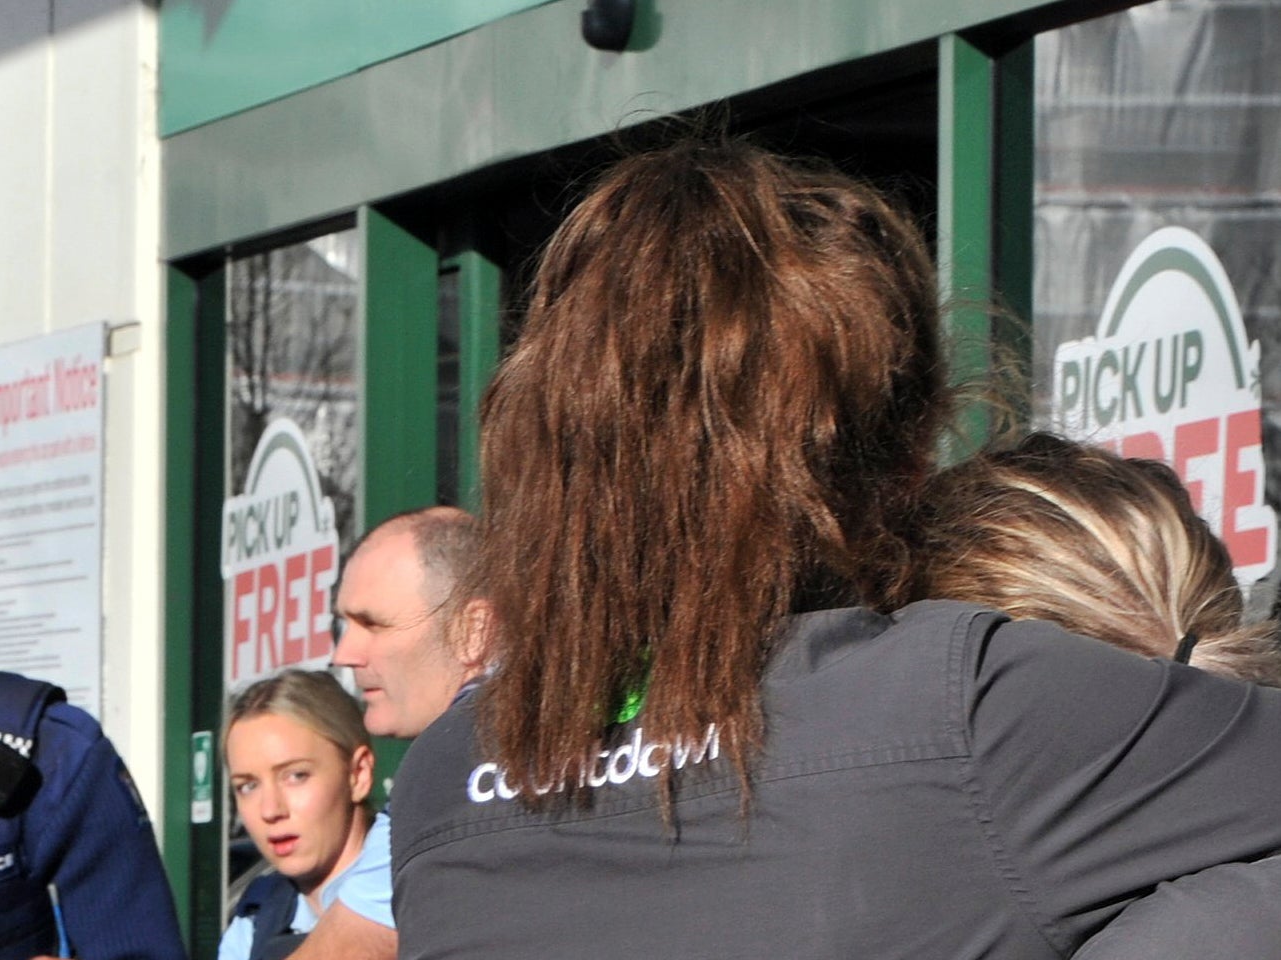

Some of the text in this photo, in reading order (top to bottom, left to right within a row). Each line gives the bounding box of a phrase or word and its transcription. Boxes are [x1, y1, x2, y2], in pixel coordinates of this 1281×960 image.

[54, 355, 97, 413] Notice
[1061, 329, 1205, 430] PICK UP
[228, 491, 300, 565] PICK UP
[1098, 408, 1268, 567] EE
[231, 544, 335, 681] FREE
